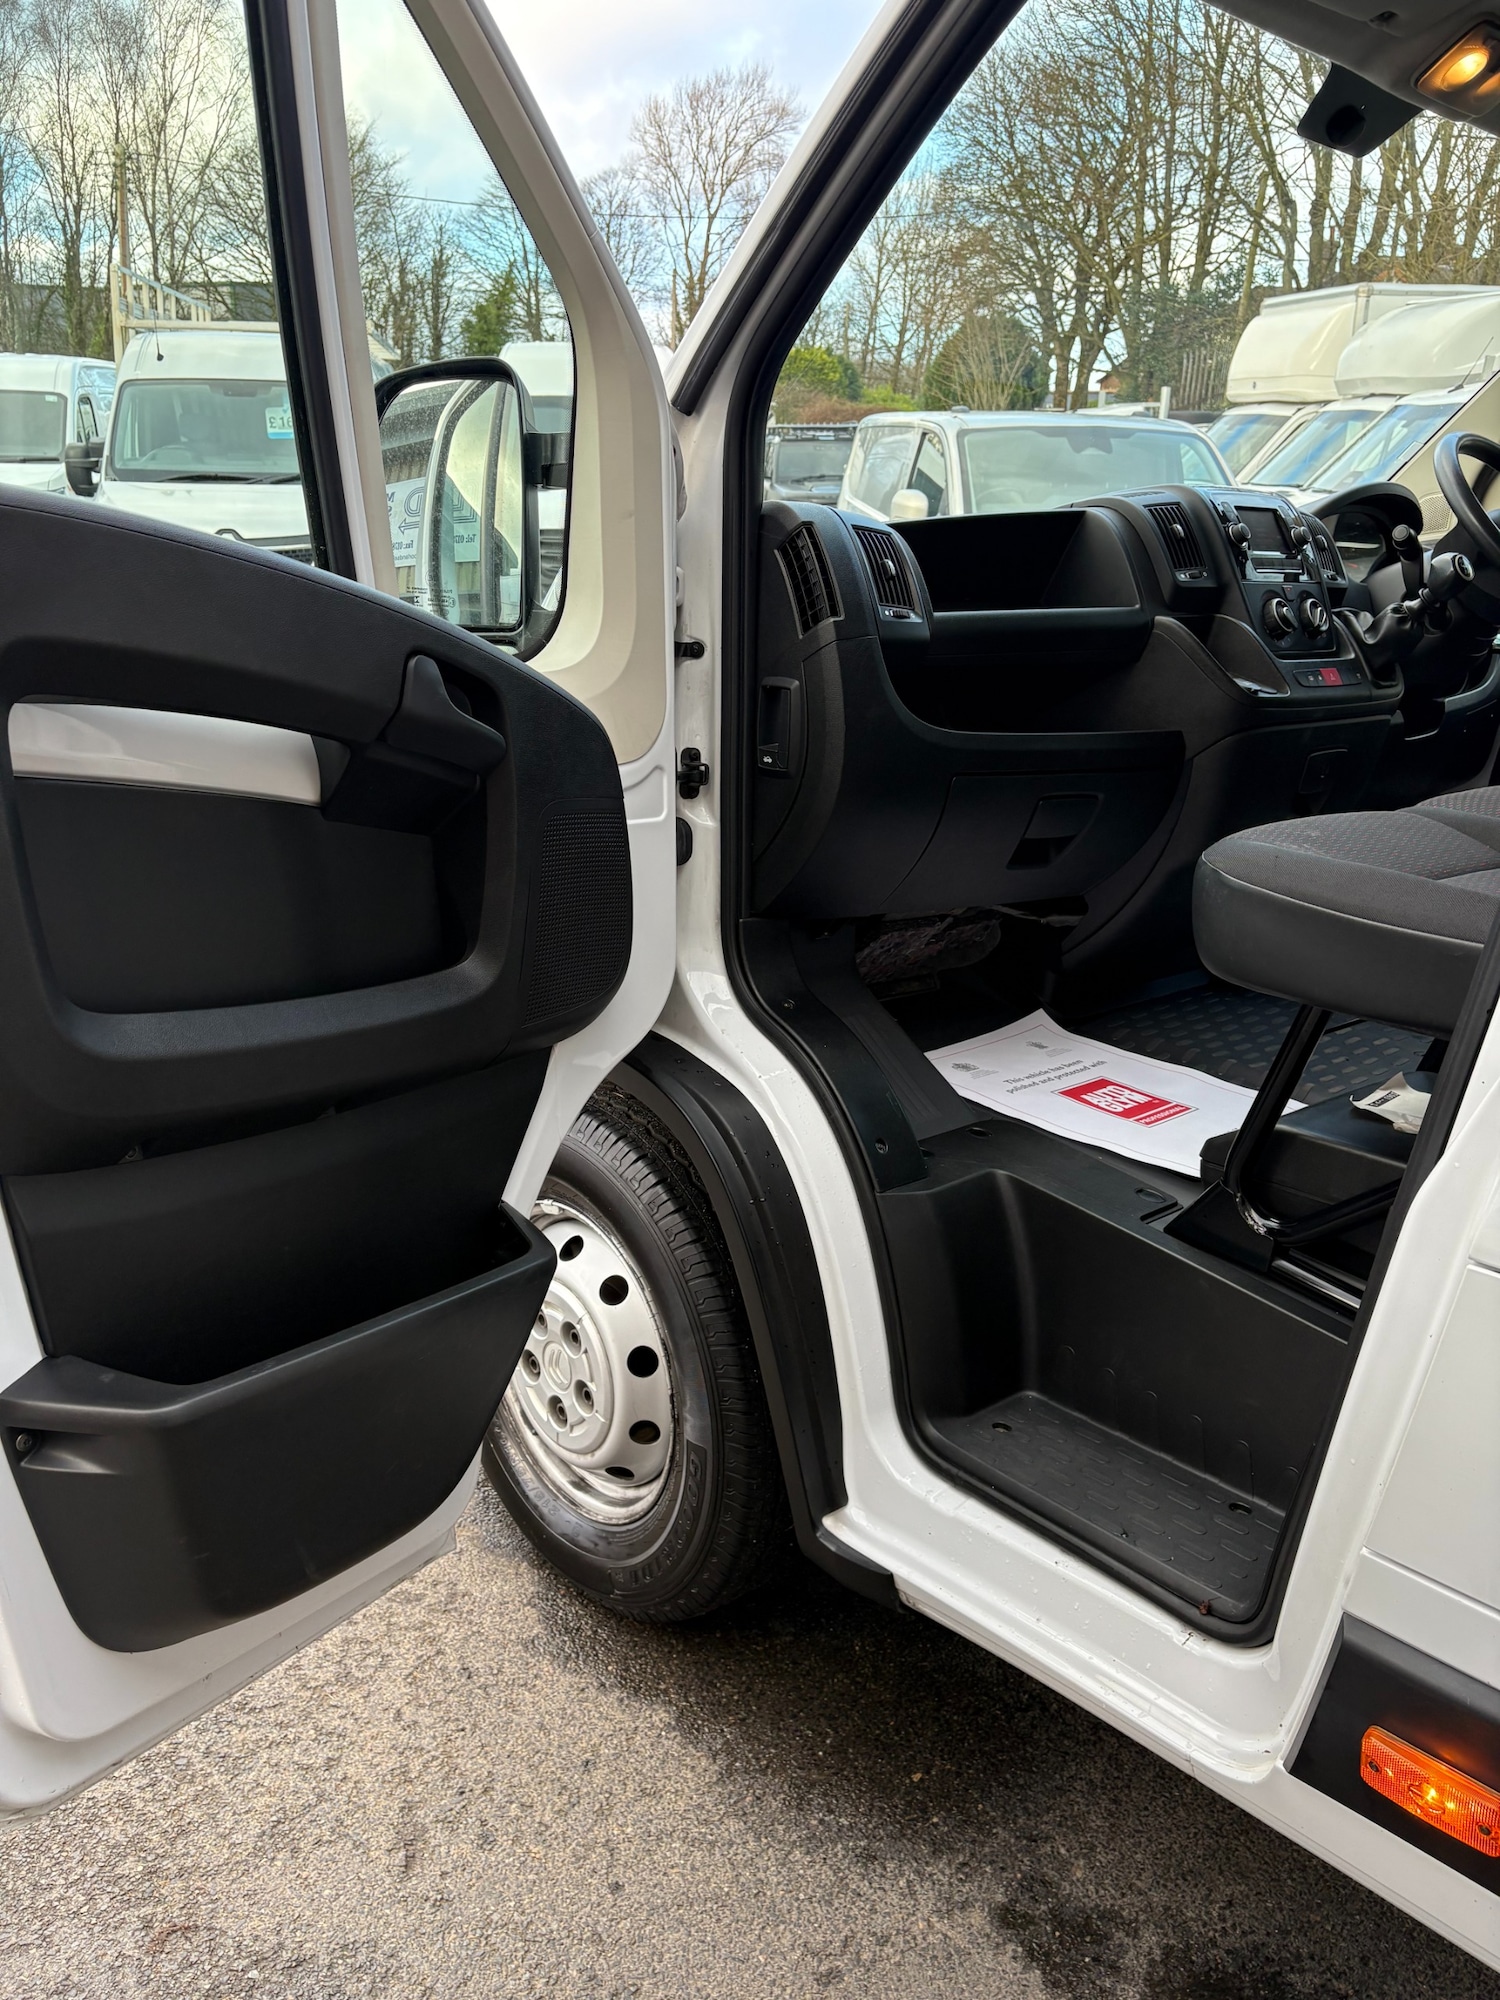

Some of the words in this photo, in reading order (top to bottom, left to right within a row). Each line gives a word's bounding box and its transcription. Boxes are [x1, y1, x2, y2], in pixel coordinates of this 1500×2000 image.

[1003, 1077, 1025, 1085] This
[1023, 1070, 1051, 1080] vehicle
[1047, 1065, 1065, 1073] has
[1060, 1059, 1083, 1068] been
[1006, 1081, 1040, 1094] polished
[1038, 1076, 1055, 1084] and
[1053, 1065, 1091, 1081] protected
[1088, 1060, 1108, 1068] with
[1080, 1085, 1131, 1107] AUTO
[1098, 1090, 1153, 1112] GLYM
